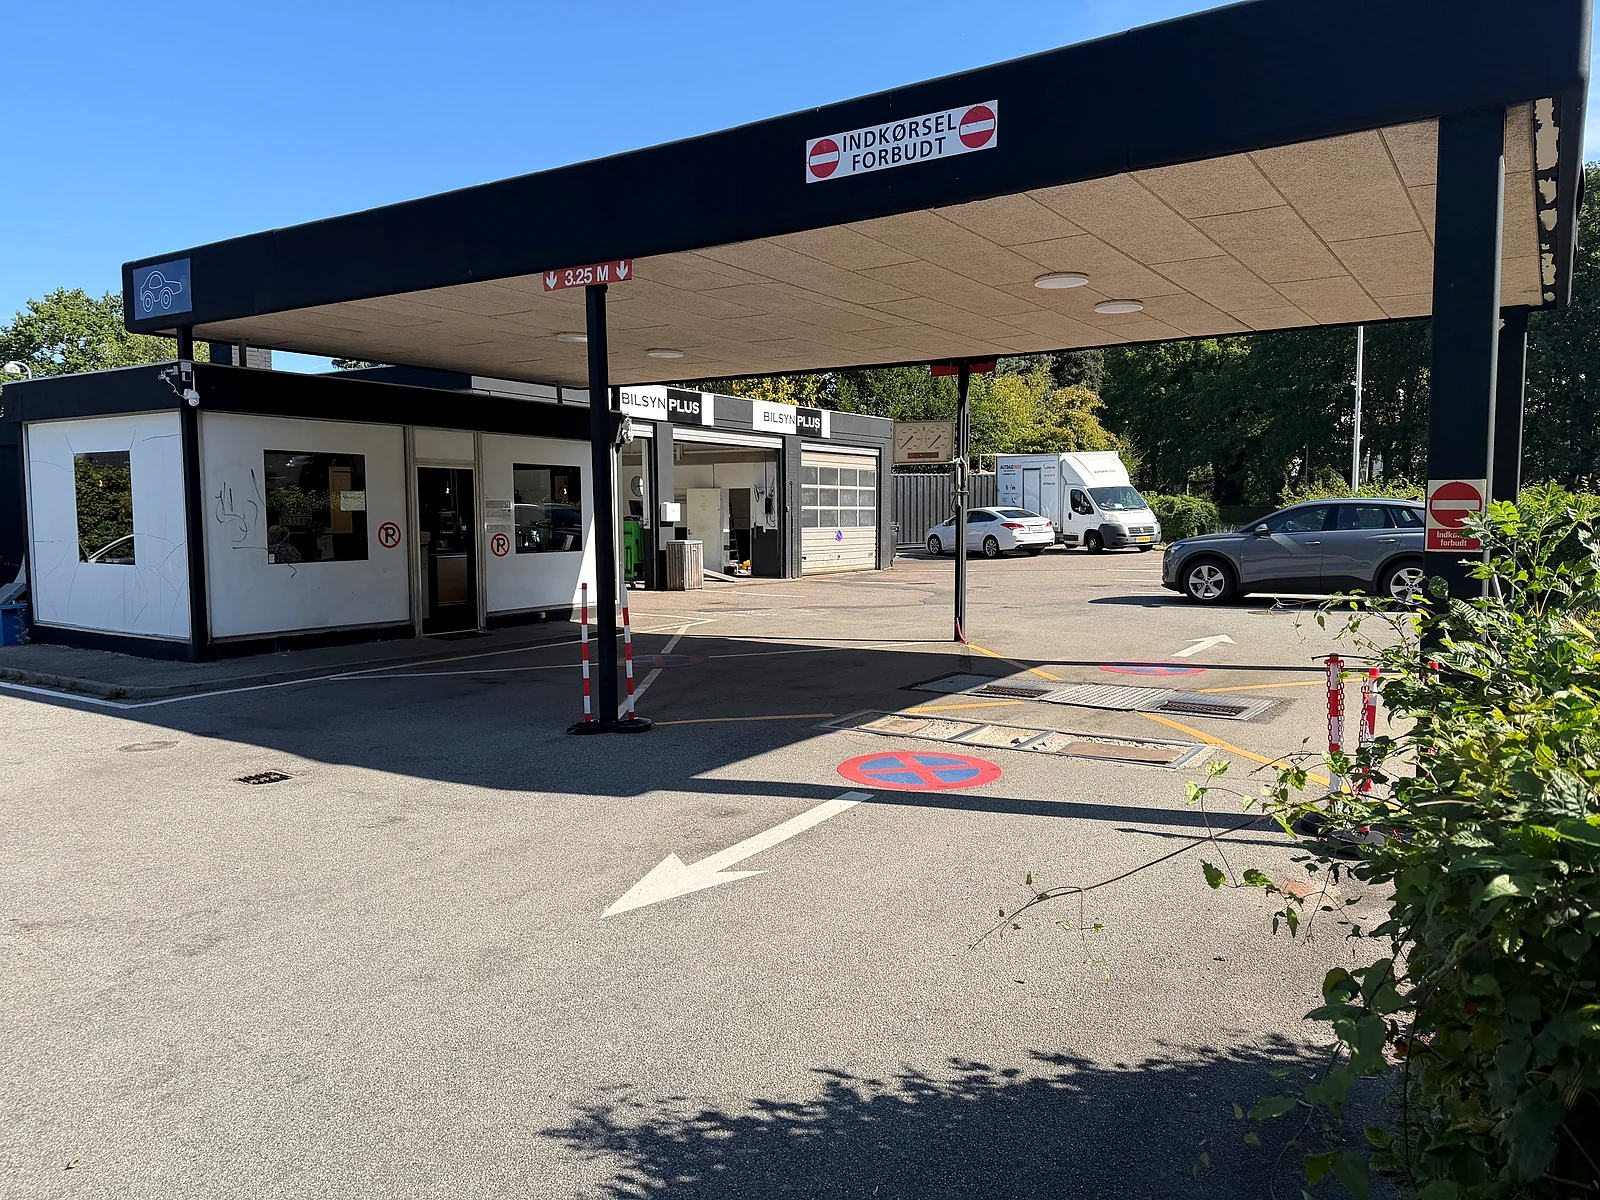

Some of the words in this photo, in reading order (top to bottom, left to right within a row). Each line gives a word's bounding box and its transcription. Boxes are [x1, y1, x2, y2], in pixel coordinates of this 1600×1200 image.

[842, 113, 957, 153] INDKØRSEL
[852, 137, 947, 171] FORBUDT
[564, 267, 593, 286] 3.25
[596, 264, 609, 282] M
[621, 392, 666, 410] BILSYN
[668, 398, 700, 415] PLUS
[763, 411, 796, 425] BILSYN
[796, 415, 821, 429] PLUS
[1440, 538, 1467, 547] forbudt
